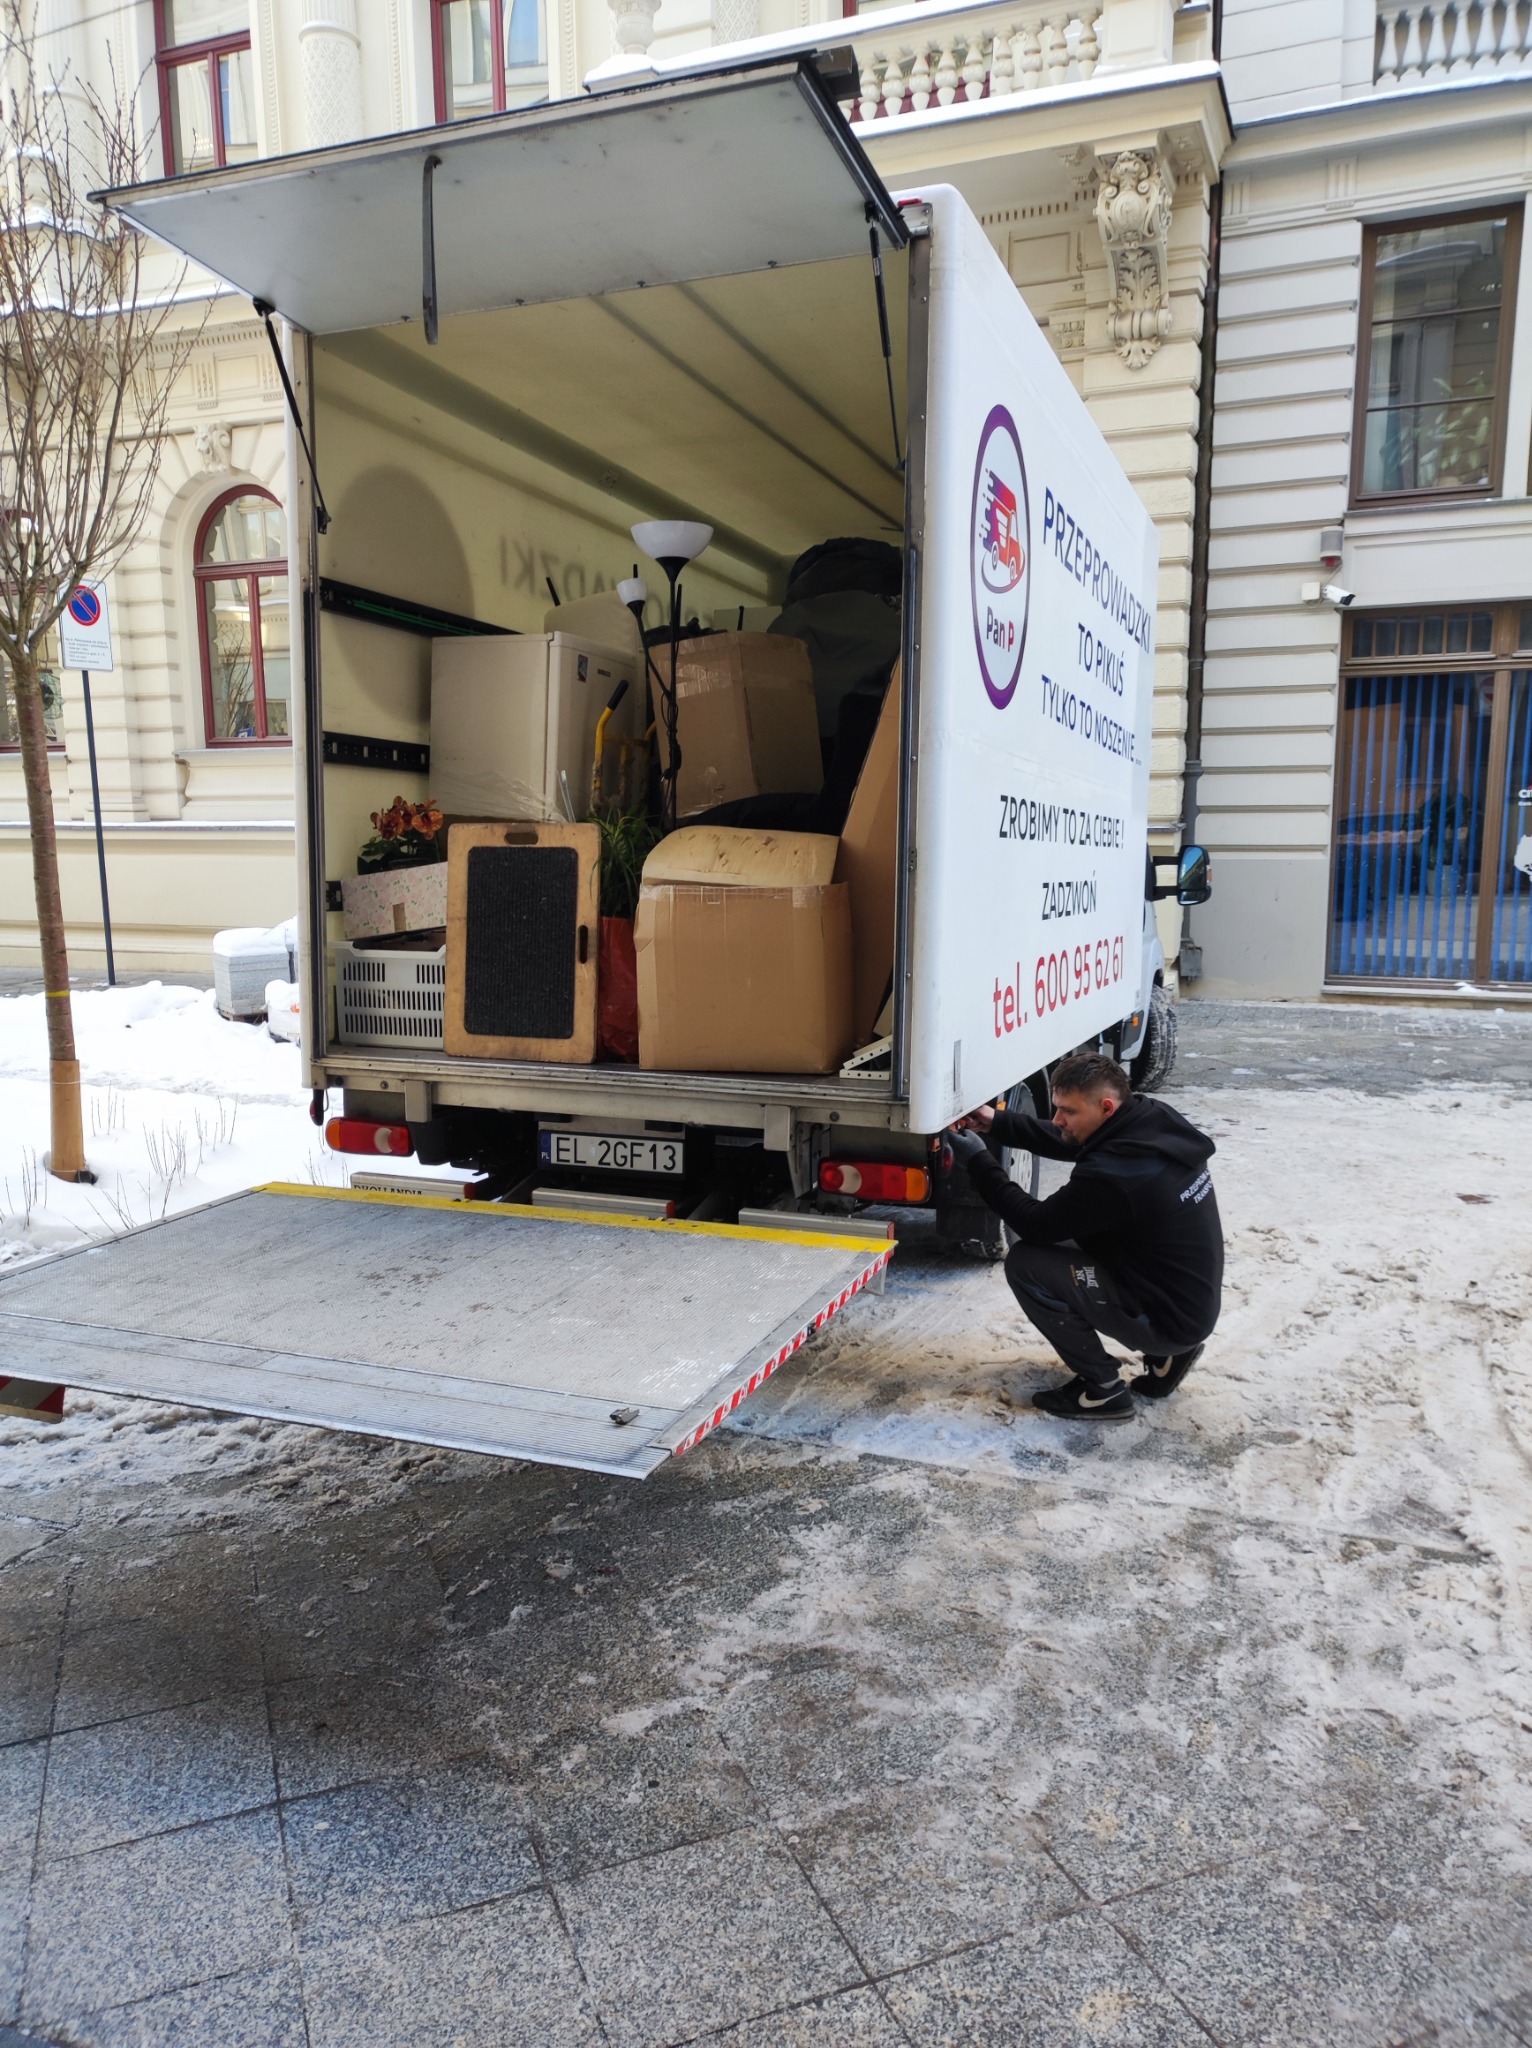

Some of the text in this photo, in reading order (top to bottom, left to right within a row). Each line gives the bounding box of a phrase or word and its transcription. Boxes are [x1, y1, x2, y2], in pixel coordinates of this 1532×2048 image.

[1043, 486, 1151, 653] PRZEPROWADZKI
[986, 605, 1006, 650] Pan
[1078, 622, 1125, 697] TO PIKUŚ
[1041, 674, 1077, 731] TYLKO
[1079, 700, 1093, 740] TO
[999, 794, 1061, 843] ZROBIMY
[1062, 807, 1077, 845] TO
[1079, 811, 1092, 847] ZA
[1041, 869, 1097, 921] ZADZWOŃ
[992, 935, 1124, 1039] tel. 600 95 62 61
[541, 1151, 550, 1160] PL
[556, 1136, 677, 1171] EL 2GF13
